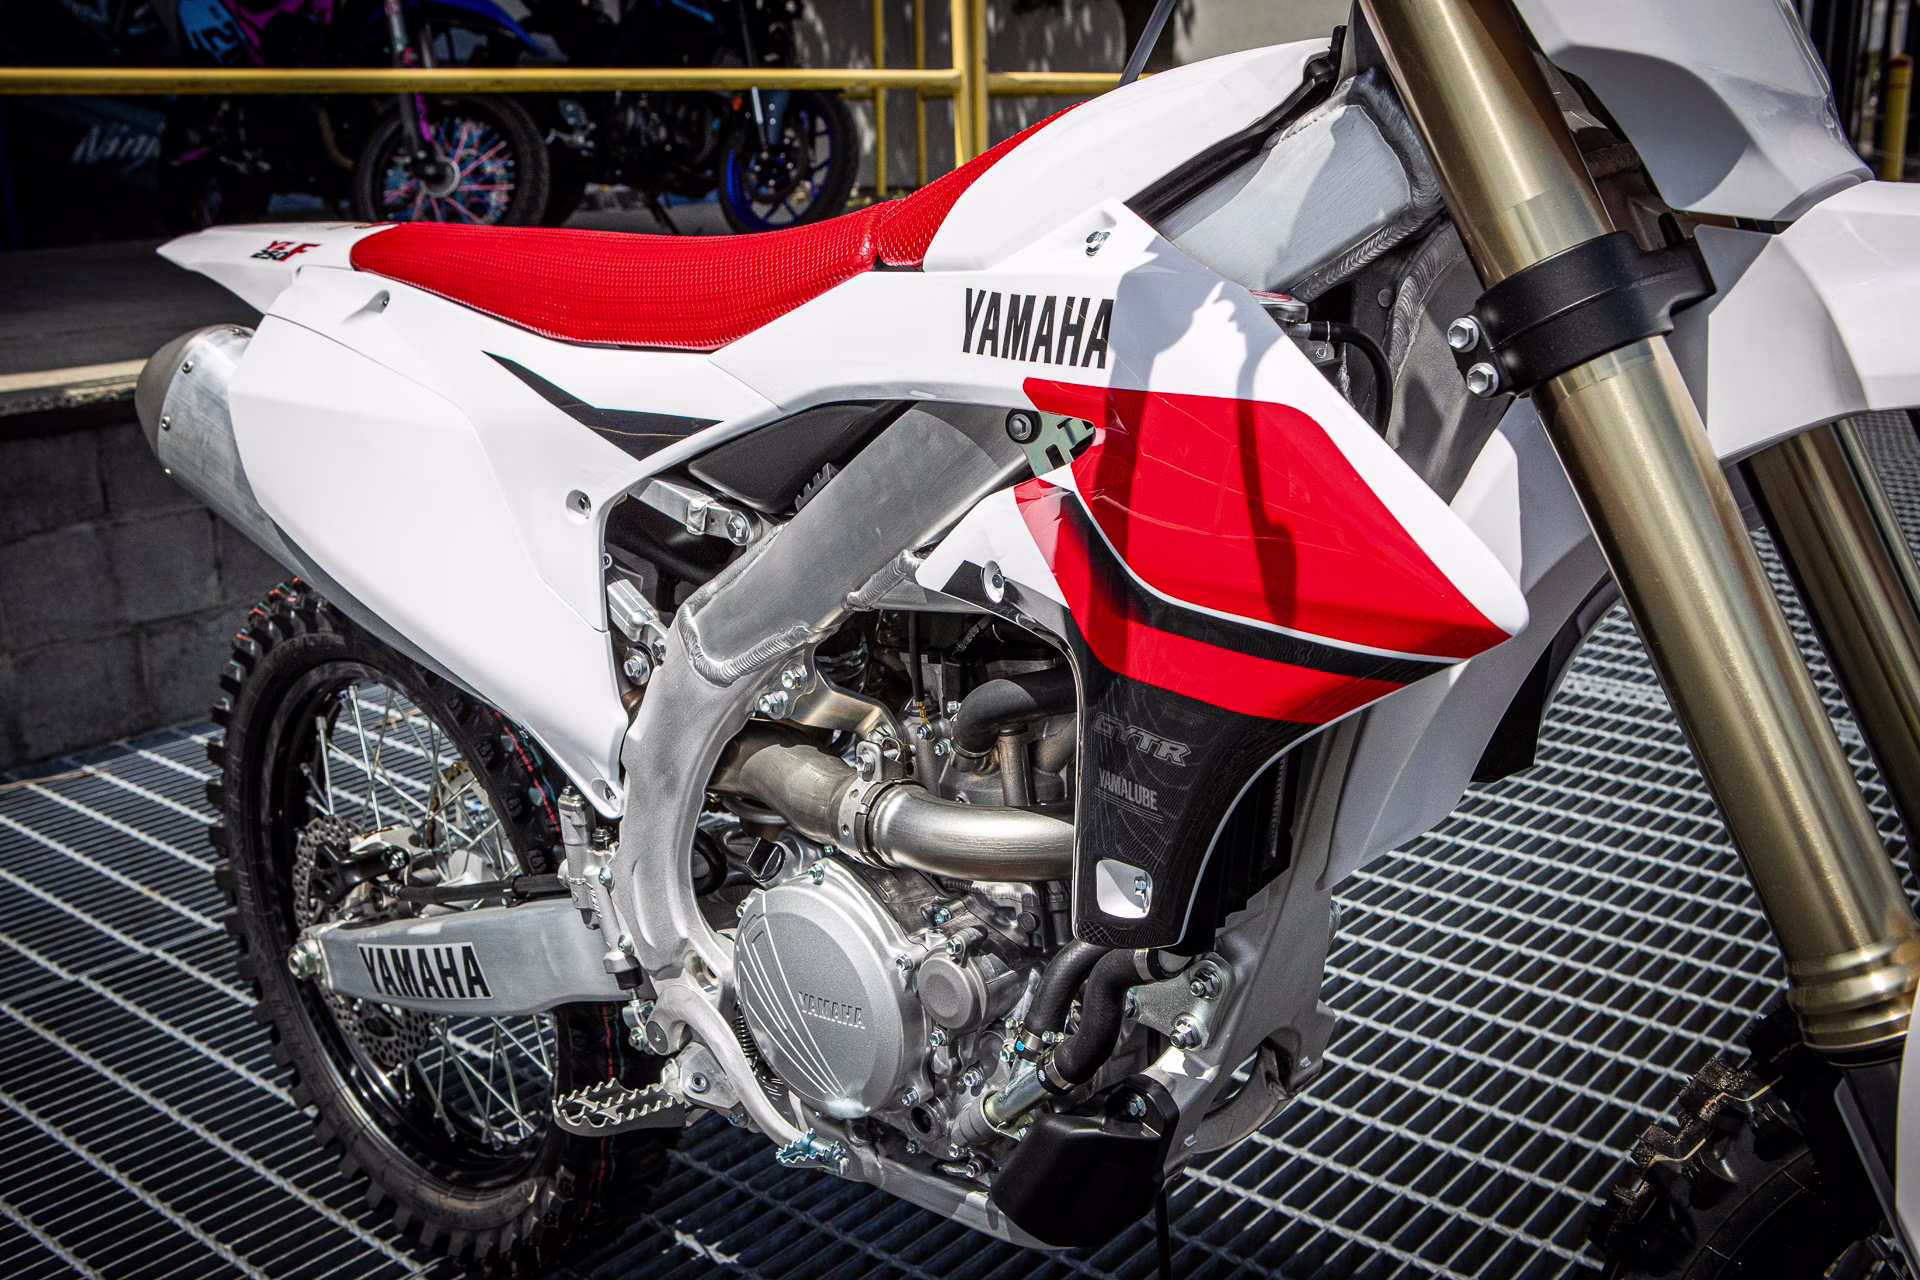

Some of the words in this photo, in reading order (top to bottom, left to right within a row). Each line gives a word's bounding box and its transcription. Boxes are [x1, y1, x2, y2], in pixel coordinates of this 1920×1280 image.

[962, 287, 1114, 369] YAMAHA
[1092, 712, 1191, 767] GYTR
[1098, 767, 1158, 811] YAMALUBE
[360, 944, 492, 998] YAMAHA
[798, 991, 866, 1029] YAMAHA
